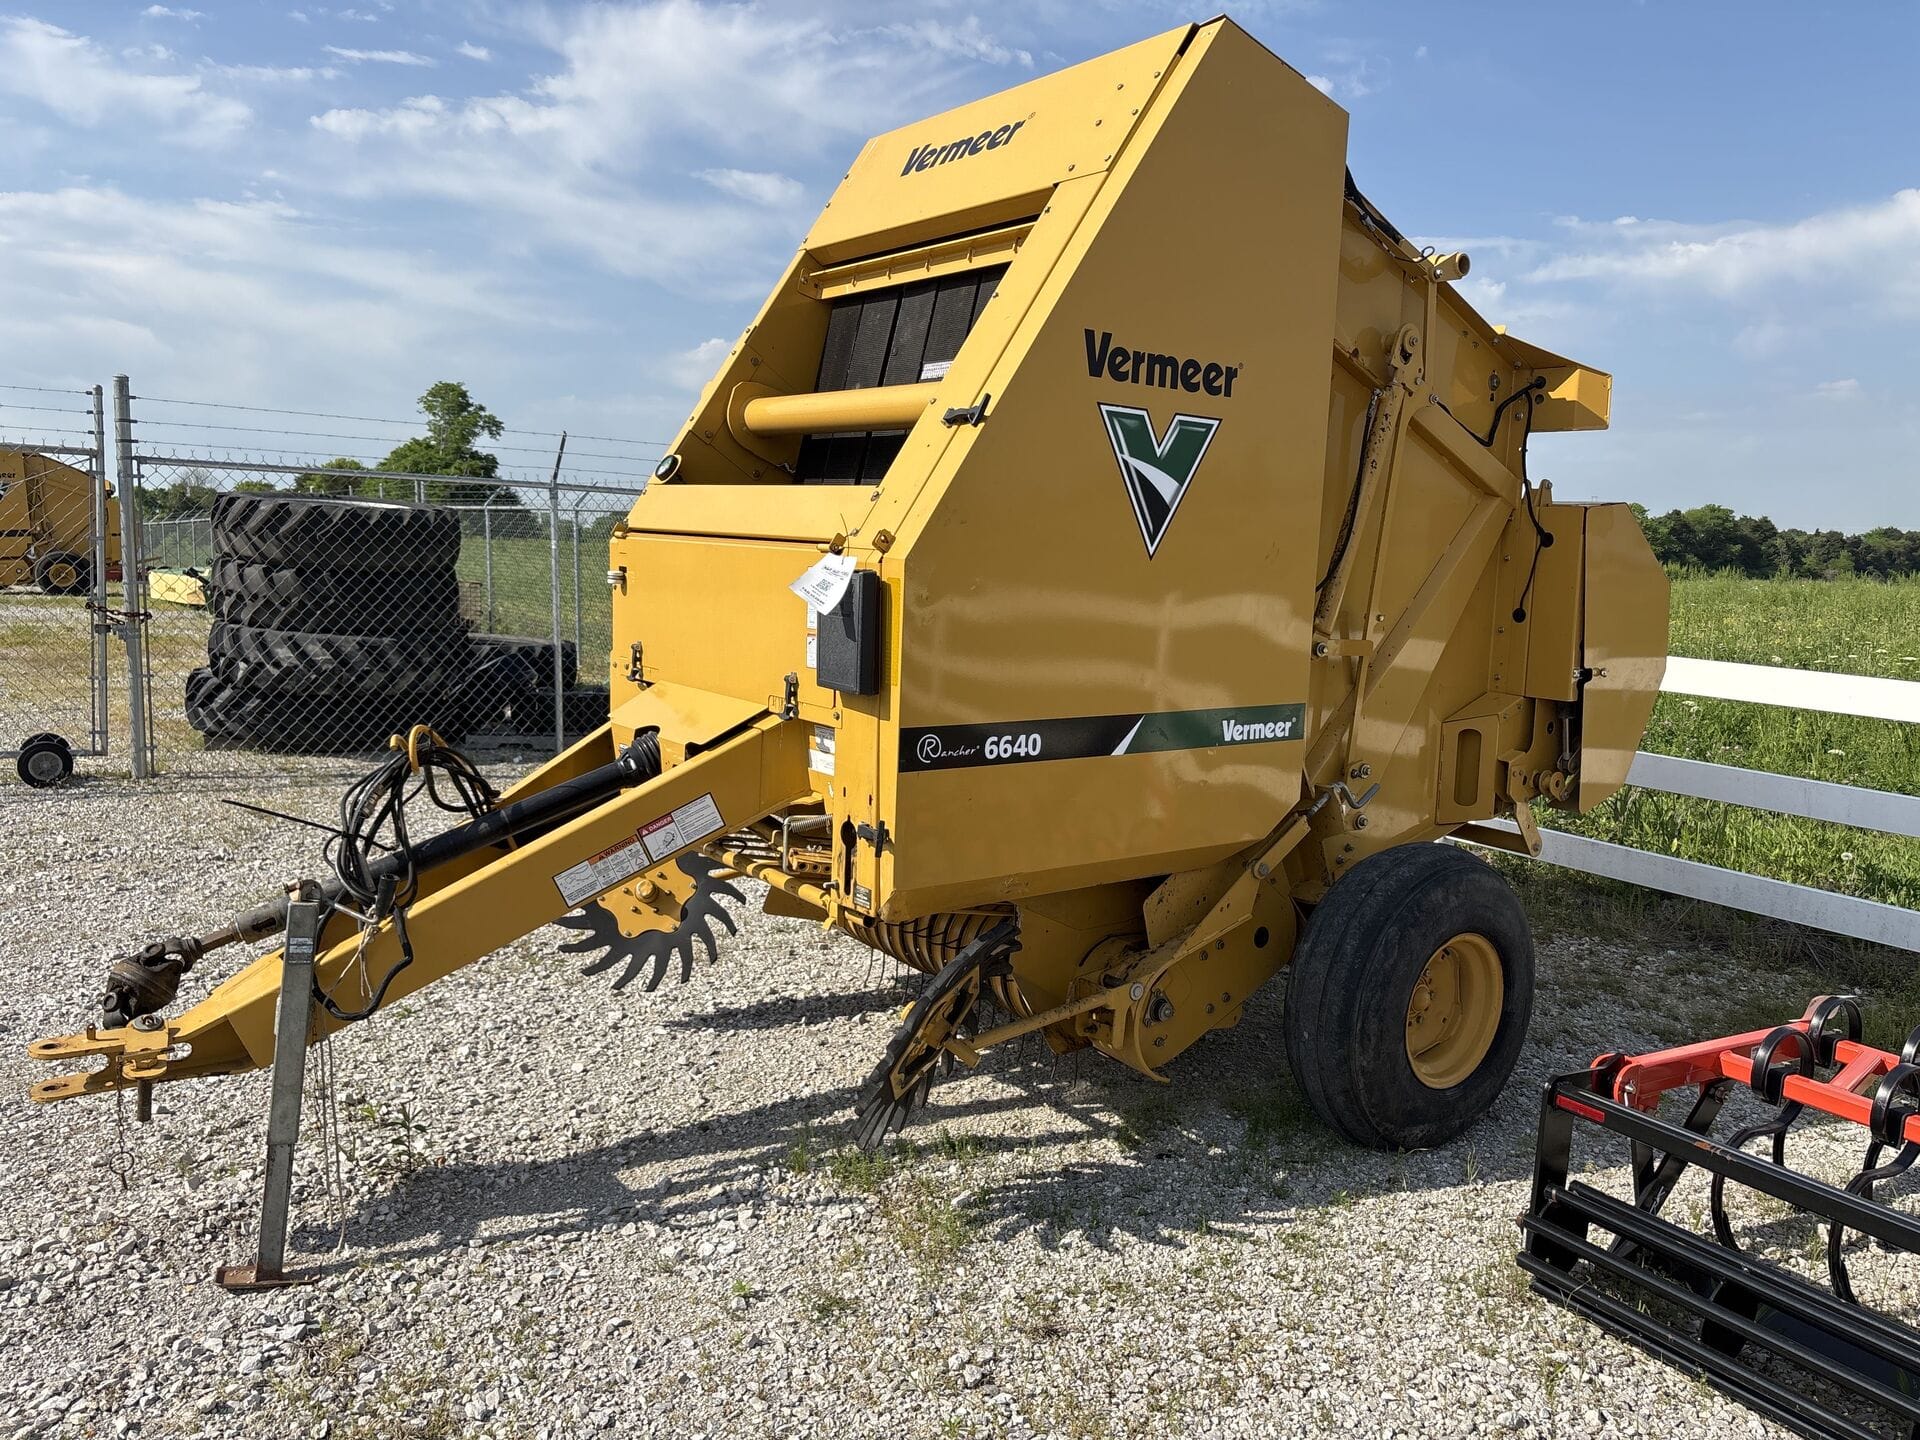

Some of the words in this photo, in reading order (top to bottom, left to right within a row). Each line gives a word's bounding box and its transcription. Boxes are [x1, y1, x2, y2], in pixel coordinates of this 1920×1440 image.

[901, 119, 1025, 177] Vermeer
[1084, 328, 1238, 397] Vermeer
[1222, 719, 1292, 742] Vermeer
[985, 733, 1042, 760] 6640
[648, 816, 673, 832] DANGER
[603, 837, 636, 858] WARNING
